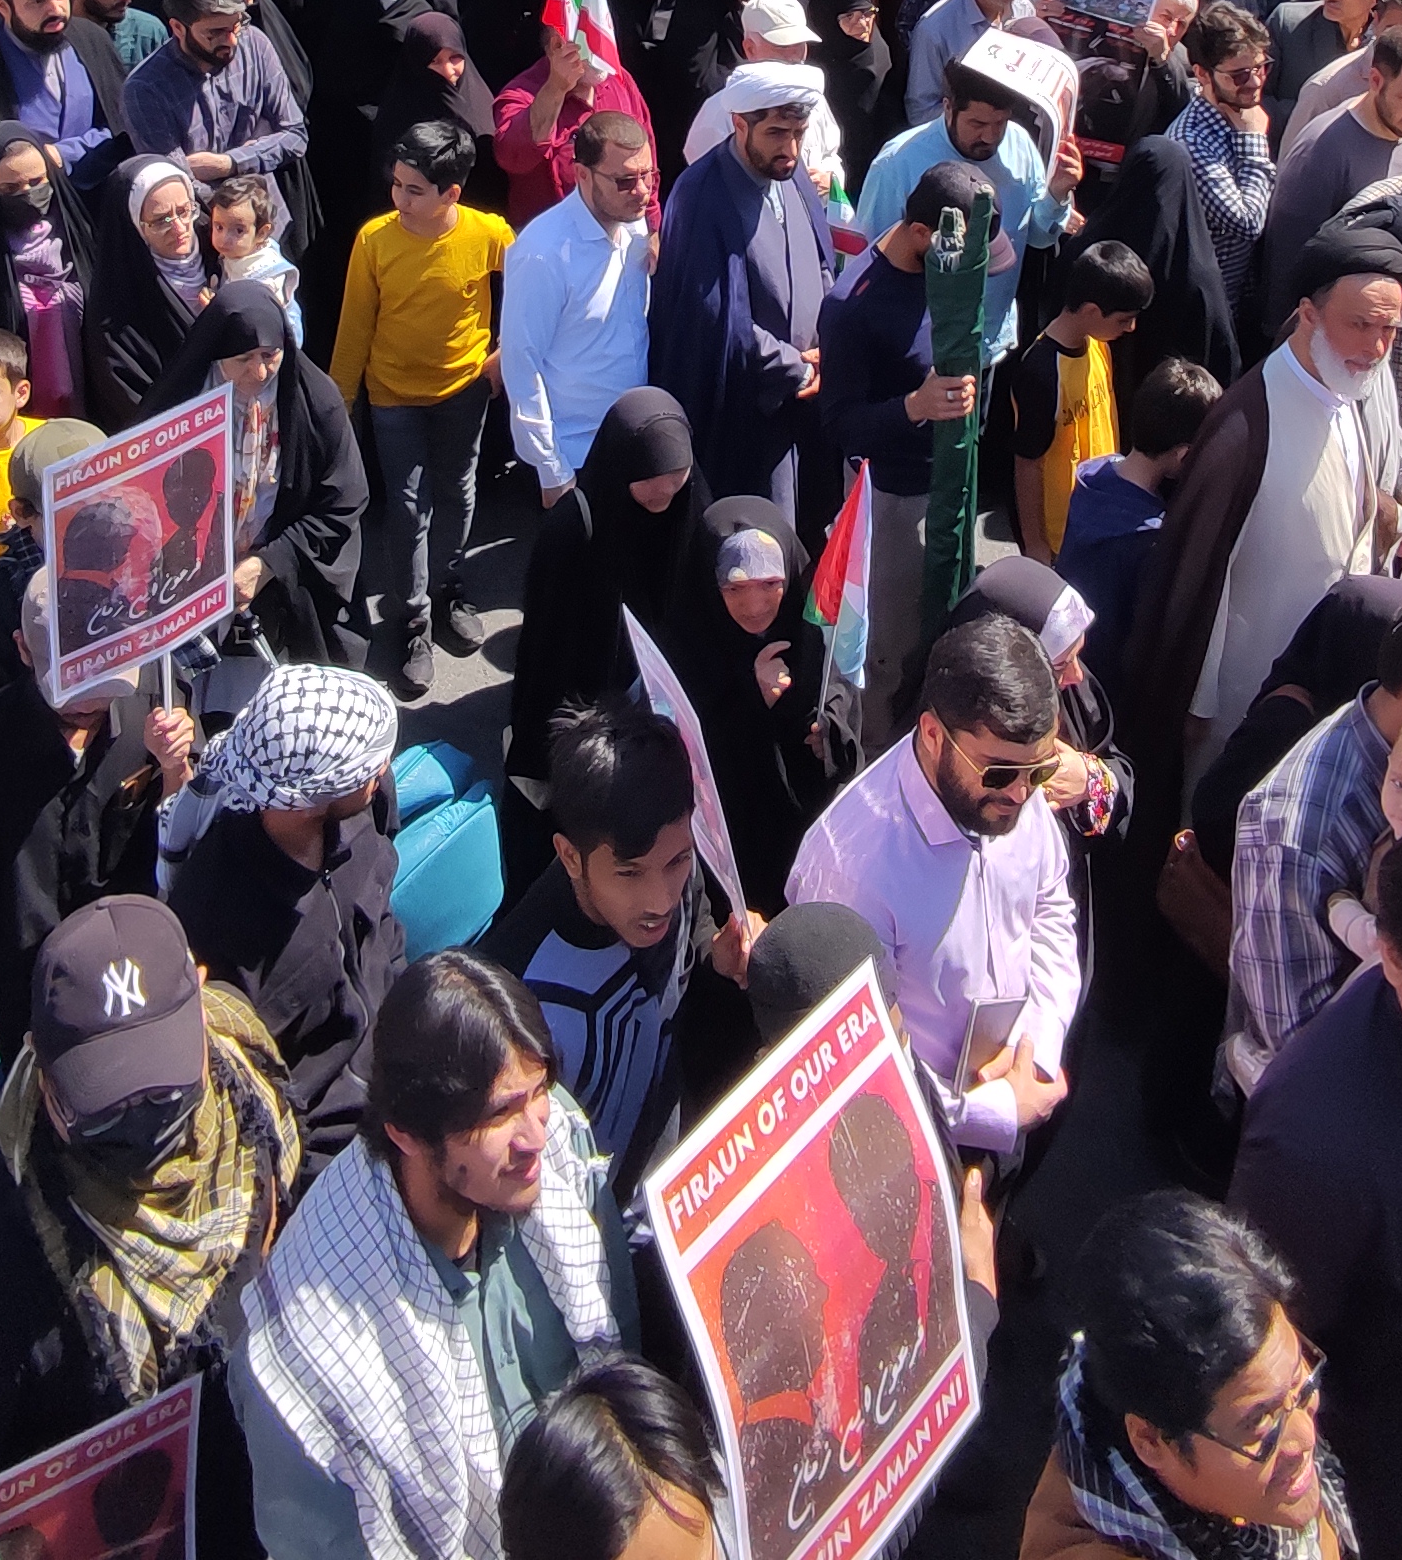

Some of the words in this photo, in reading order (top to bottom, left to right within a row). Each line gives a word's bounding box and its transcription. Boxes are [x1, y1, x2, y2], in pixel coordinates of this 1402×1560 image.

[55, 448, 123, 493] FIRAUN
[127, 440, 150, 462] OF
[154, 420, 191, 447] OUR
[194, 403, 224, 428] ERA
[64, 643, 133, 680] FIRAUN
[139, 609, 197, 646] ZAMAN
[201, 590, 224, 608] INI
[668, 1122, 756, 1233] FIRAUN
[757, 1087, 787, 1136] OF
[790, 1041, 838, 1100] OUR
[836, 1002, 878, 1054] ERA
[44, 1453, 78, 1480] OF
[85, 1422, 137, 1458] OUR
[146, 1397, 189, 1424] ERA
[857, 1419, 932, 1530] ZAMAN
[934, 1373, 962, 1430] INI
